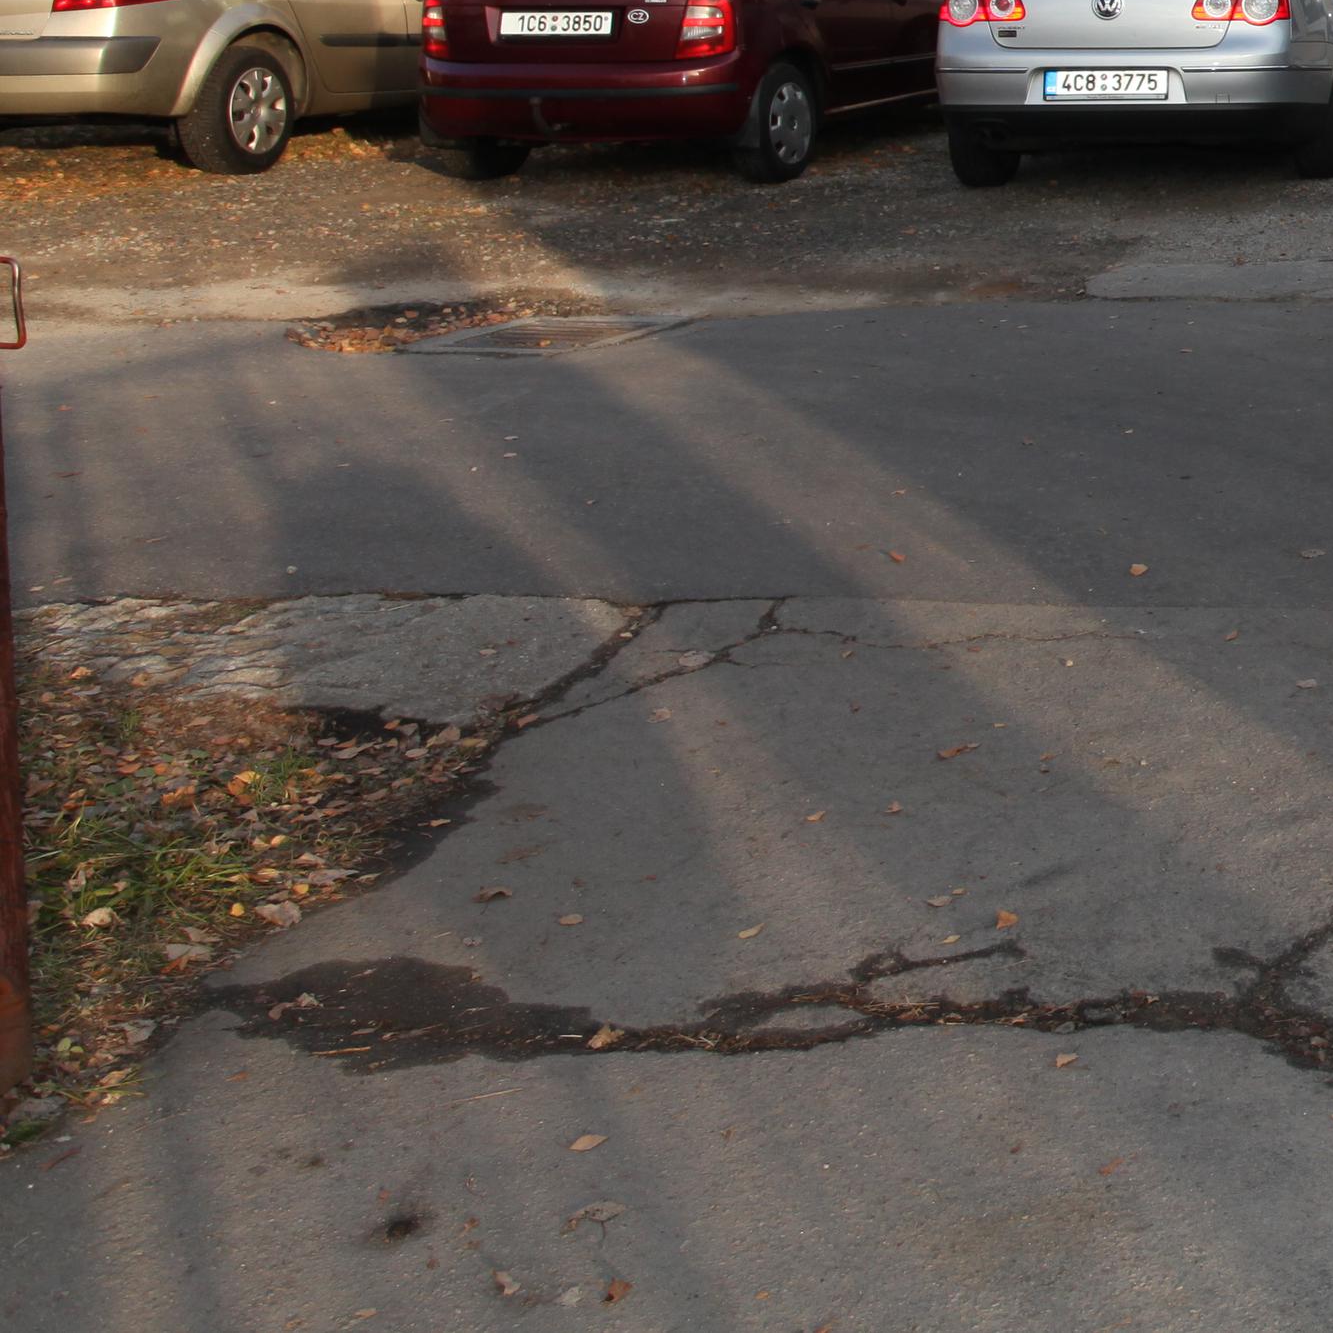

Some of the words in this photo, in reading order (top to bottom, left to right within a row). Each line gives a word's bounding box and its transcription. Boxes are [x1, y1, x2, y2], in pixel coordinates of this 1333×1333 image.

[518, 15, 547, 33] 1C6
[561, 15, 603, 33] 3850
[1062, 73, 1096, 91] 4C8
[1112, 73, 1158, 91] 3775
